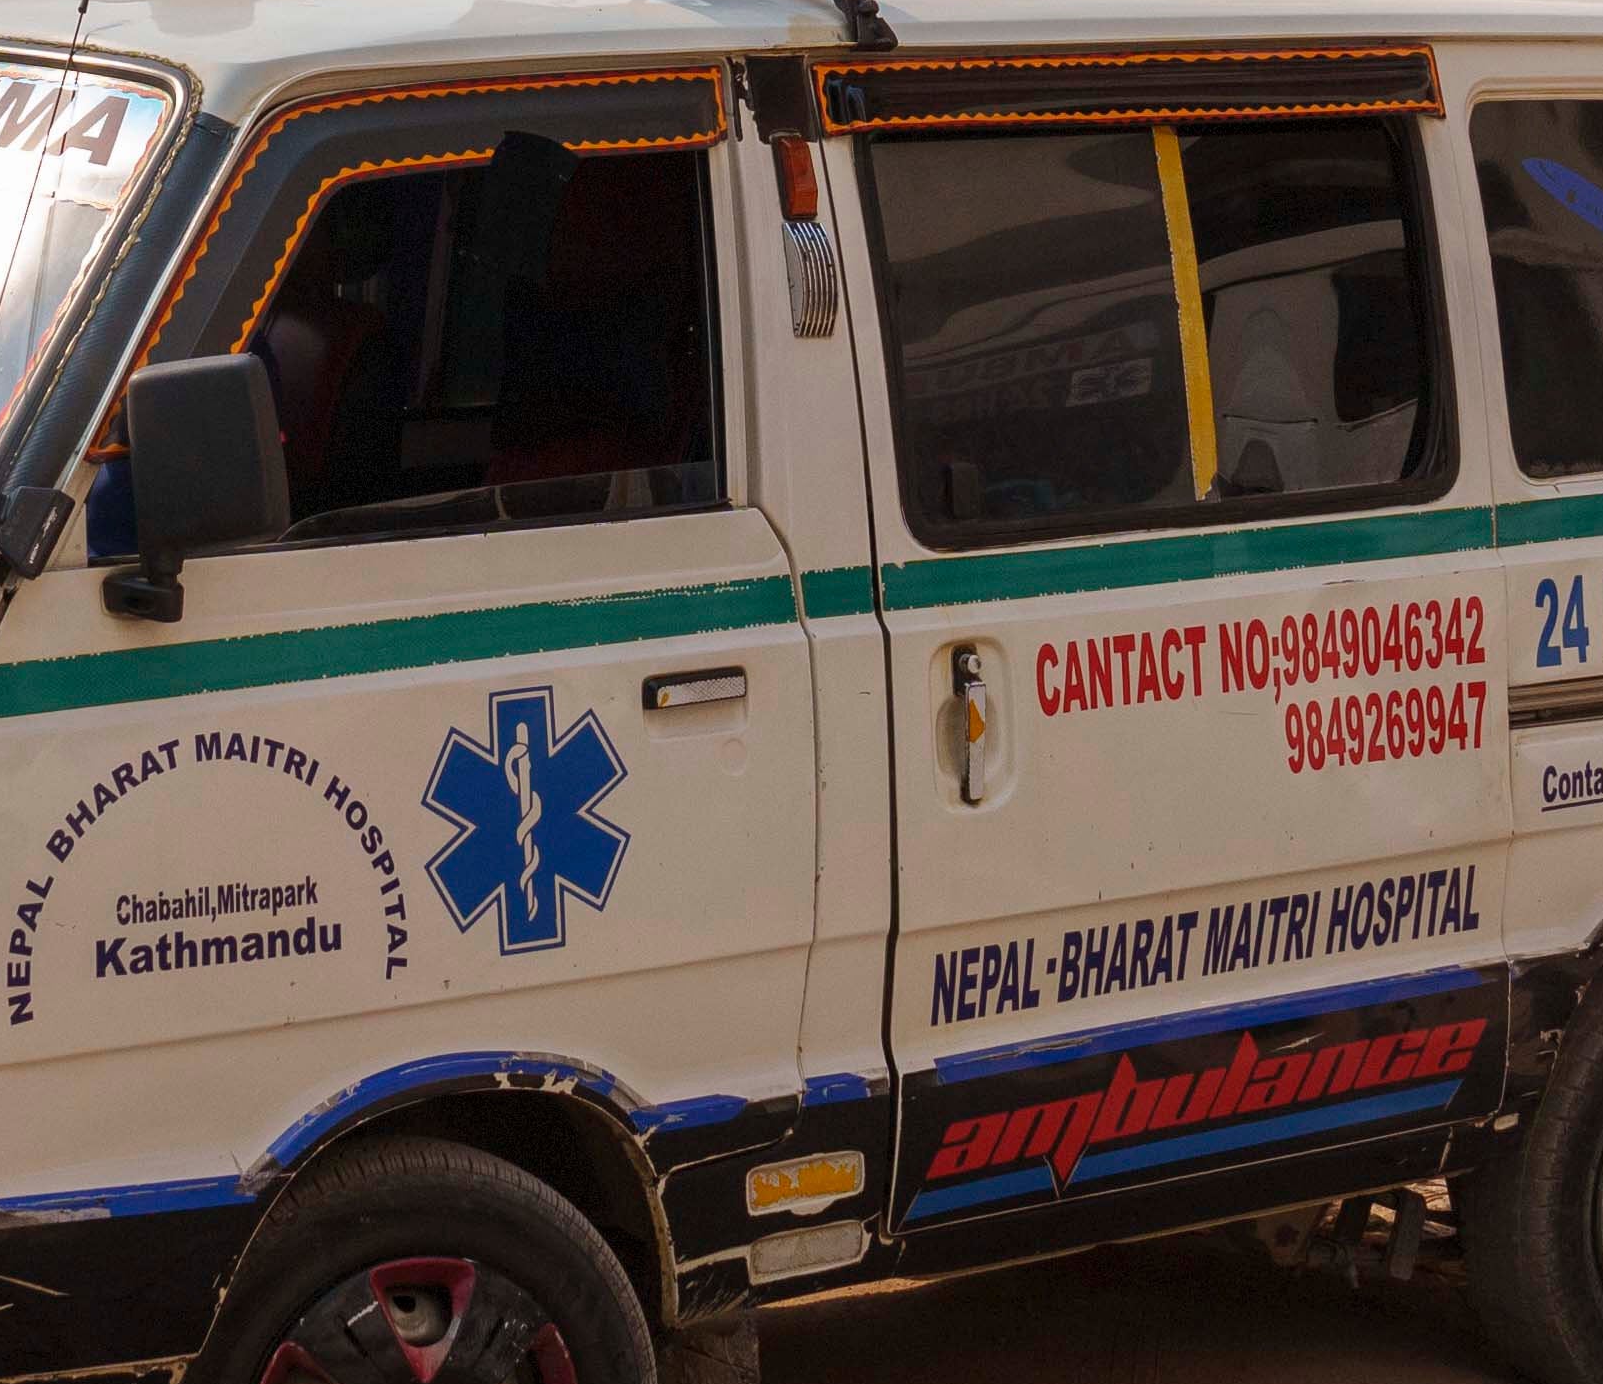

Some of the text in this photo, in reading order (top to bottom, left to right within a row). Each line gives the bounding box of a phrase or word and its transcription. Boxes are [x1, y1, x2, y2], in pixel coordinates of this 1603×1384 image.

[1535, 574, 1590, 668] 24
[1035, 625, 1206, 717] CANTACT
[1284, 680, 1487, 774] 9849269947
[6, 731, 408, 1026] NEPAL BHARAT MAITRI HOSPITAL
[95, 916, 343, 979] Kathmandu
[930, 937, 1043, 1027] NEPAL
[1202, 890, 1322, 977] MAITRI
[1325, 864, 1480, 956] HOSPITAL
[925, 1017, 1489, 1184] ambulance
